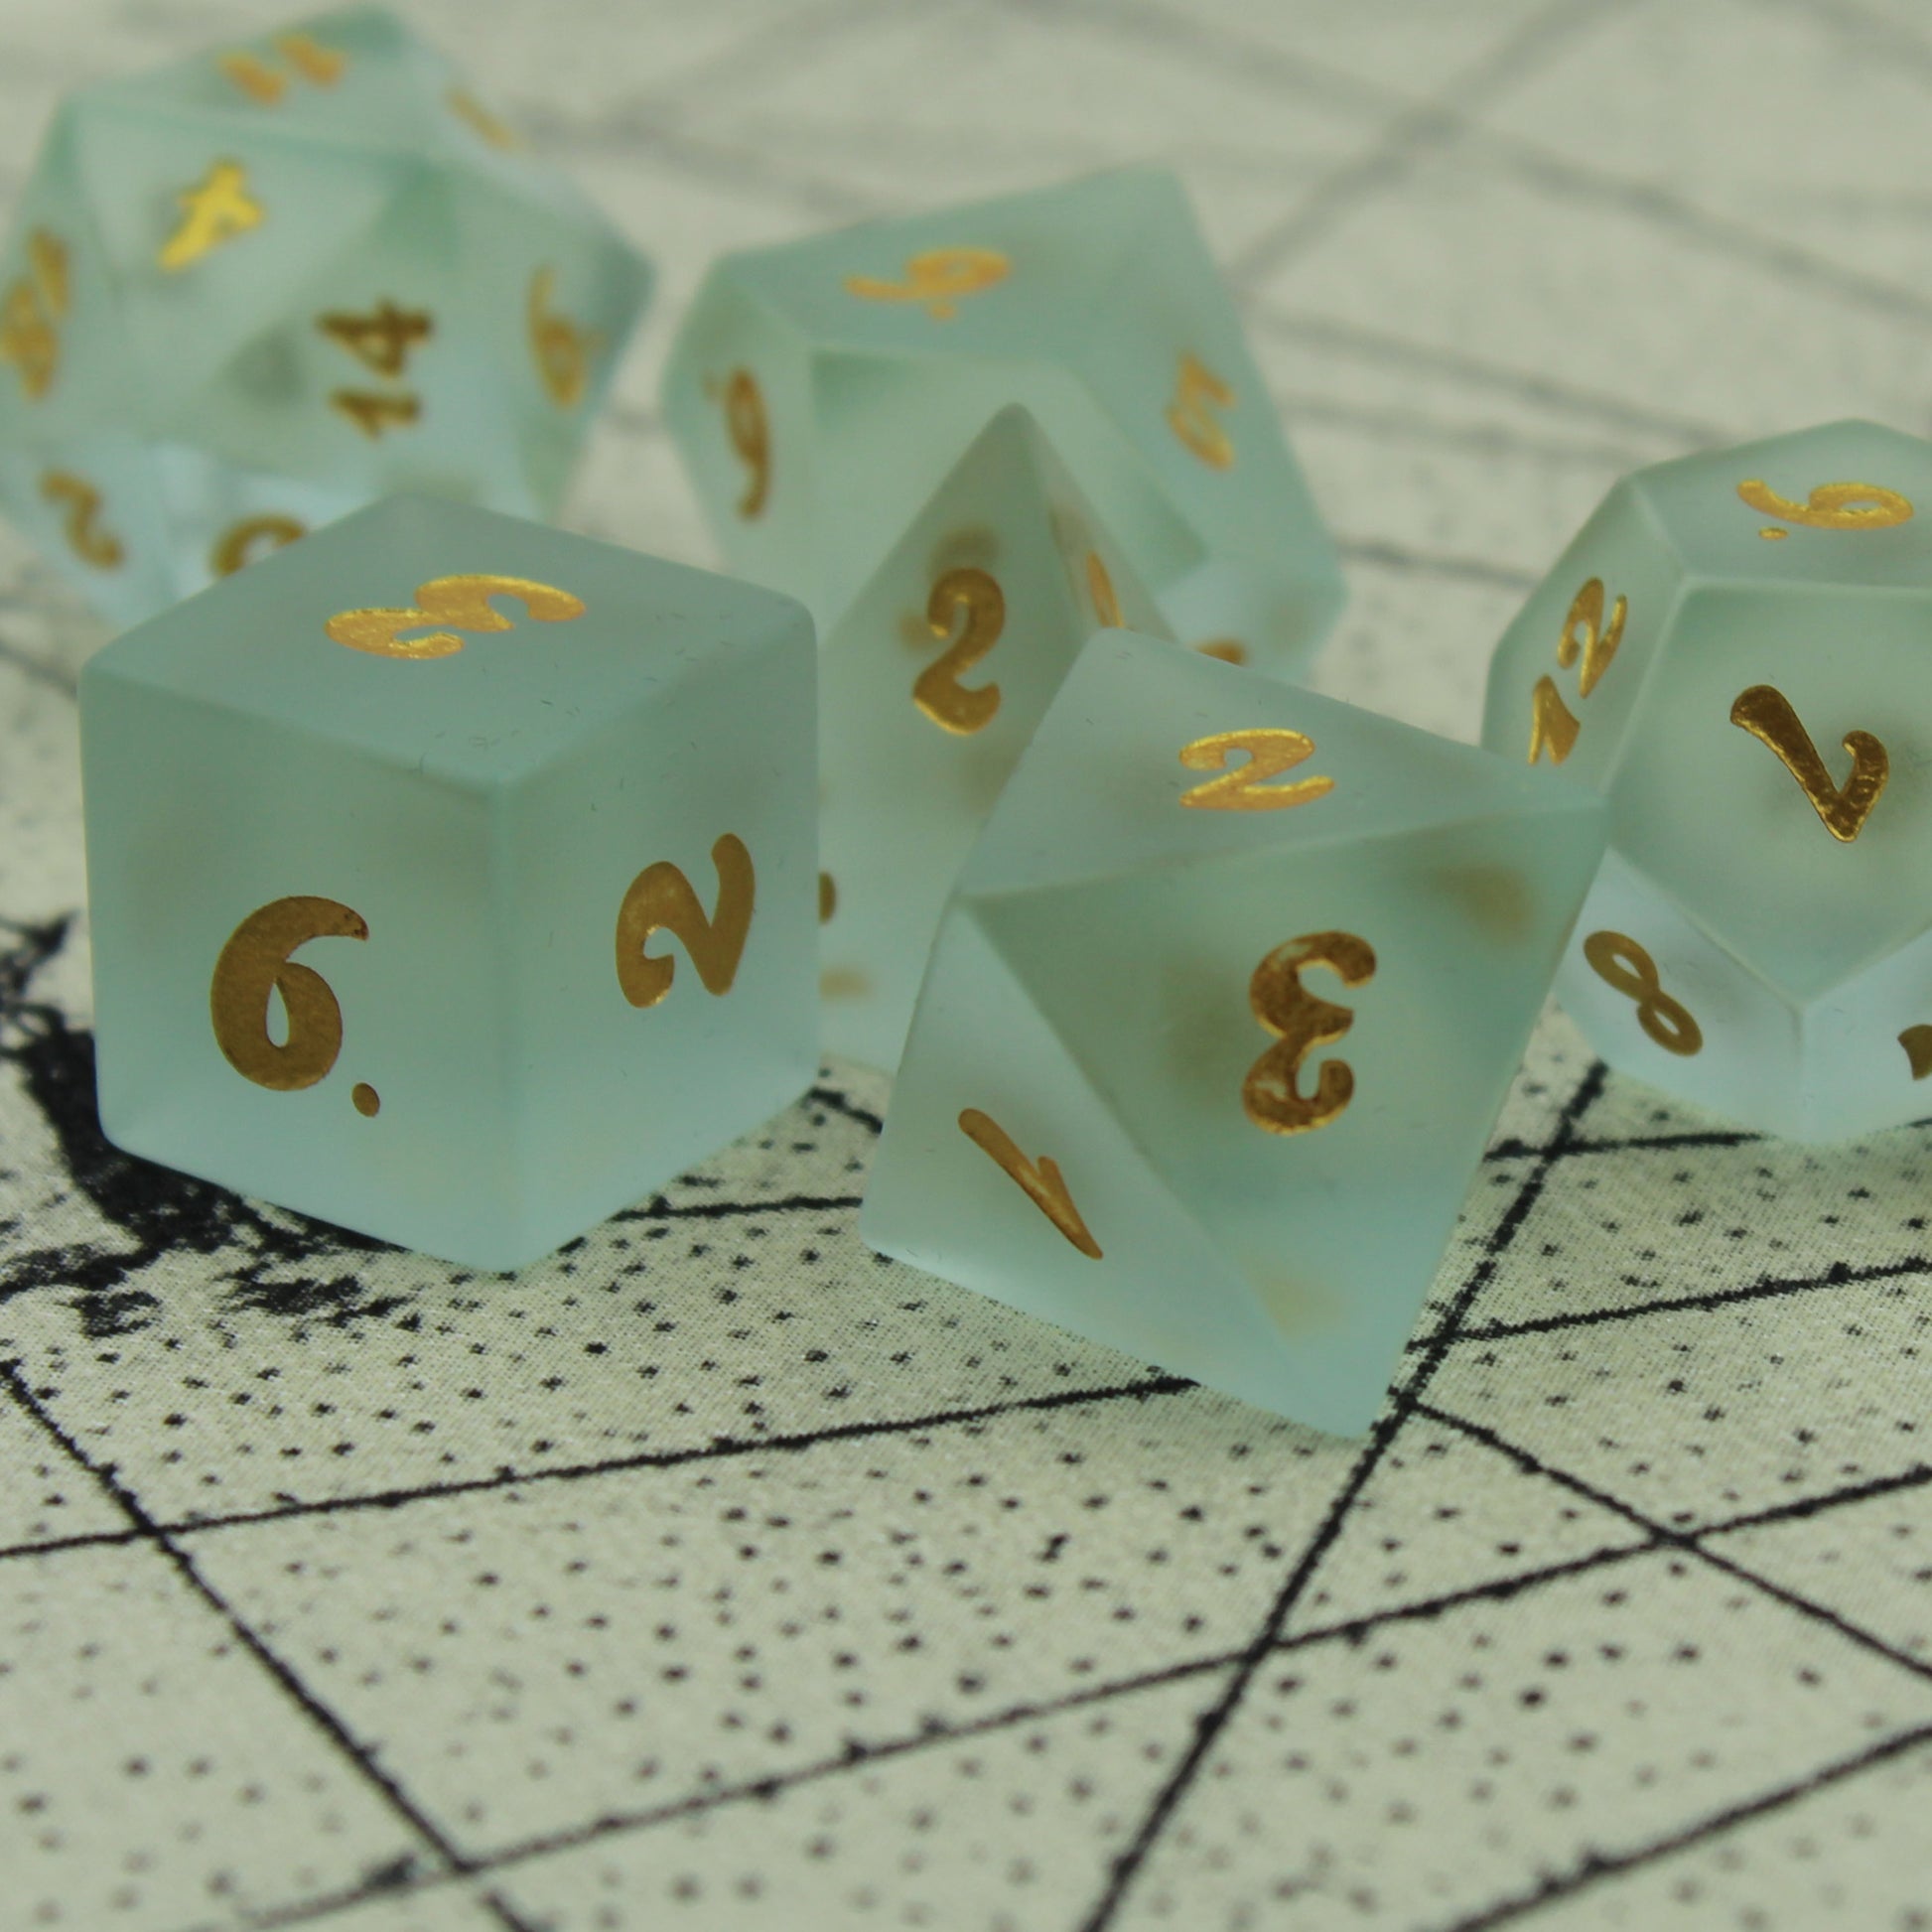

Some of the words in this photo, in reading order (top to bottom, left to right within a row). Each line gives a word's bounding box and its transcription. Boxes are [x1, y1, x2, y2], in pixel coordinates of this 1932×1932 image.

[158, 160, 264, 271] 4
[315, 300, 431, 440] 14
[324, 573, 585, 660] 3
[902, 565, 1005, 738] 2
[1527, 577, 1628, 765] 12
[1177, 727, 1336, 811] 2
[614, 832, 756, 1009] 2
[1584, 929, 1705, 1057] 8
[1241, 930, 1375, 1137] 3
[956, 1107, 1103, 1261] 1
